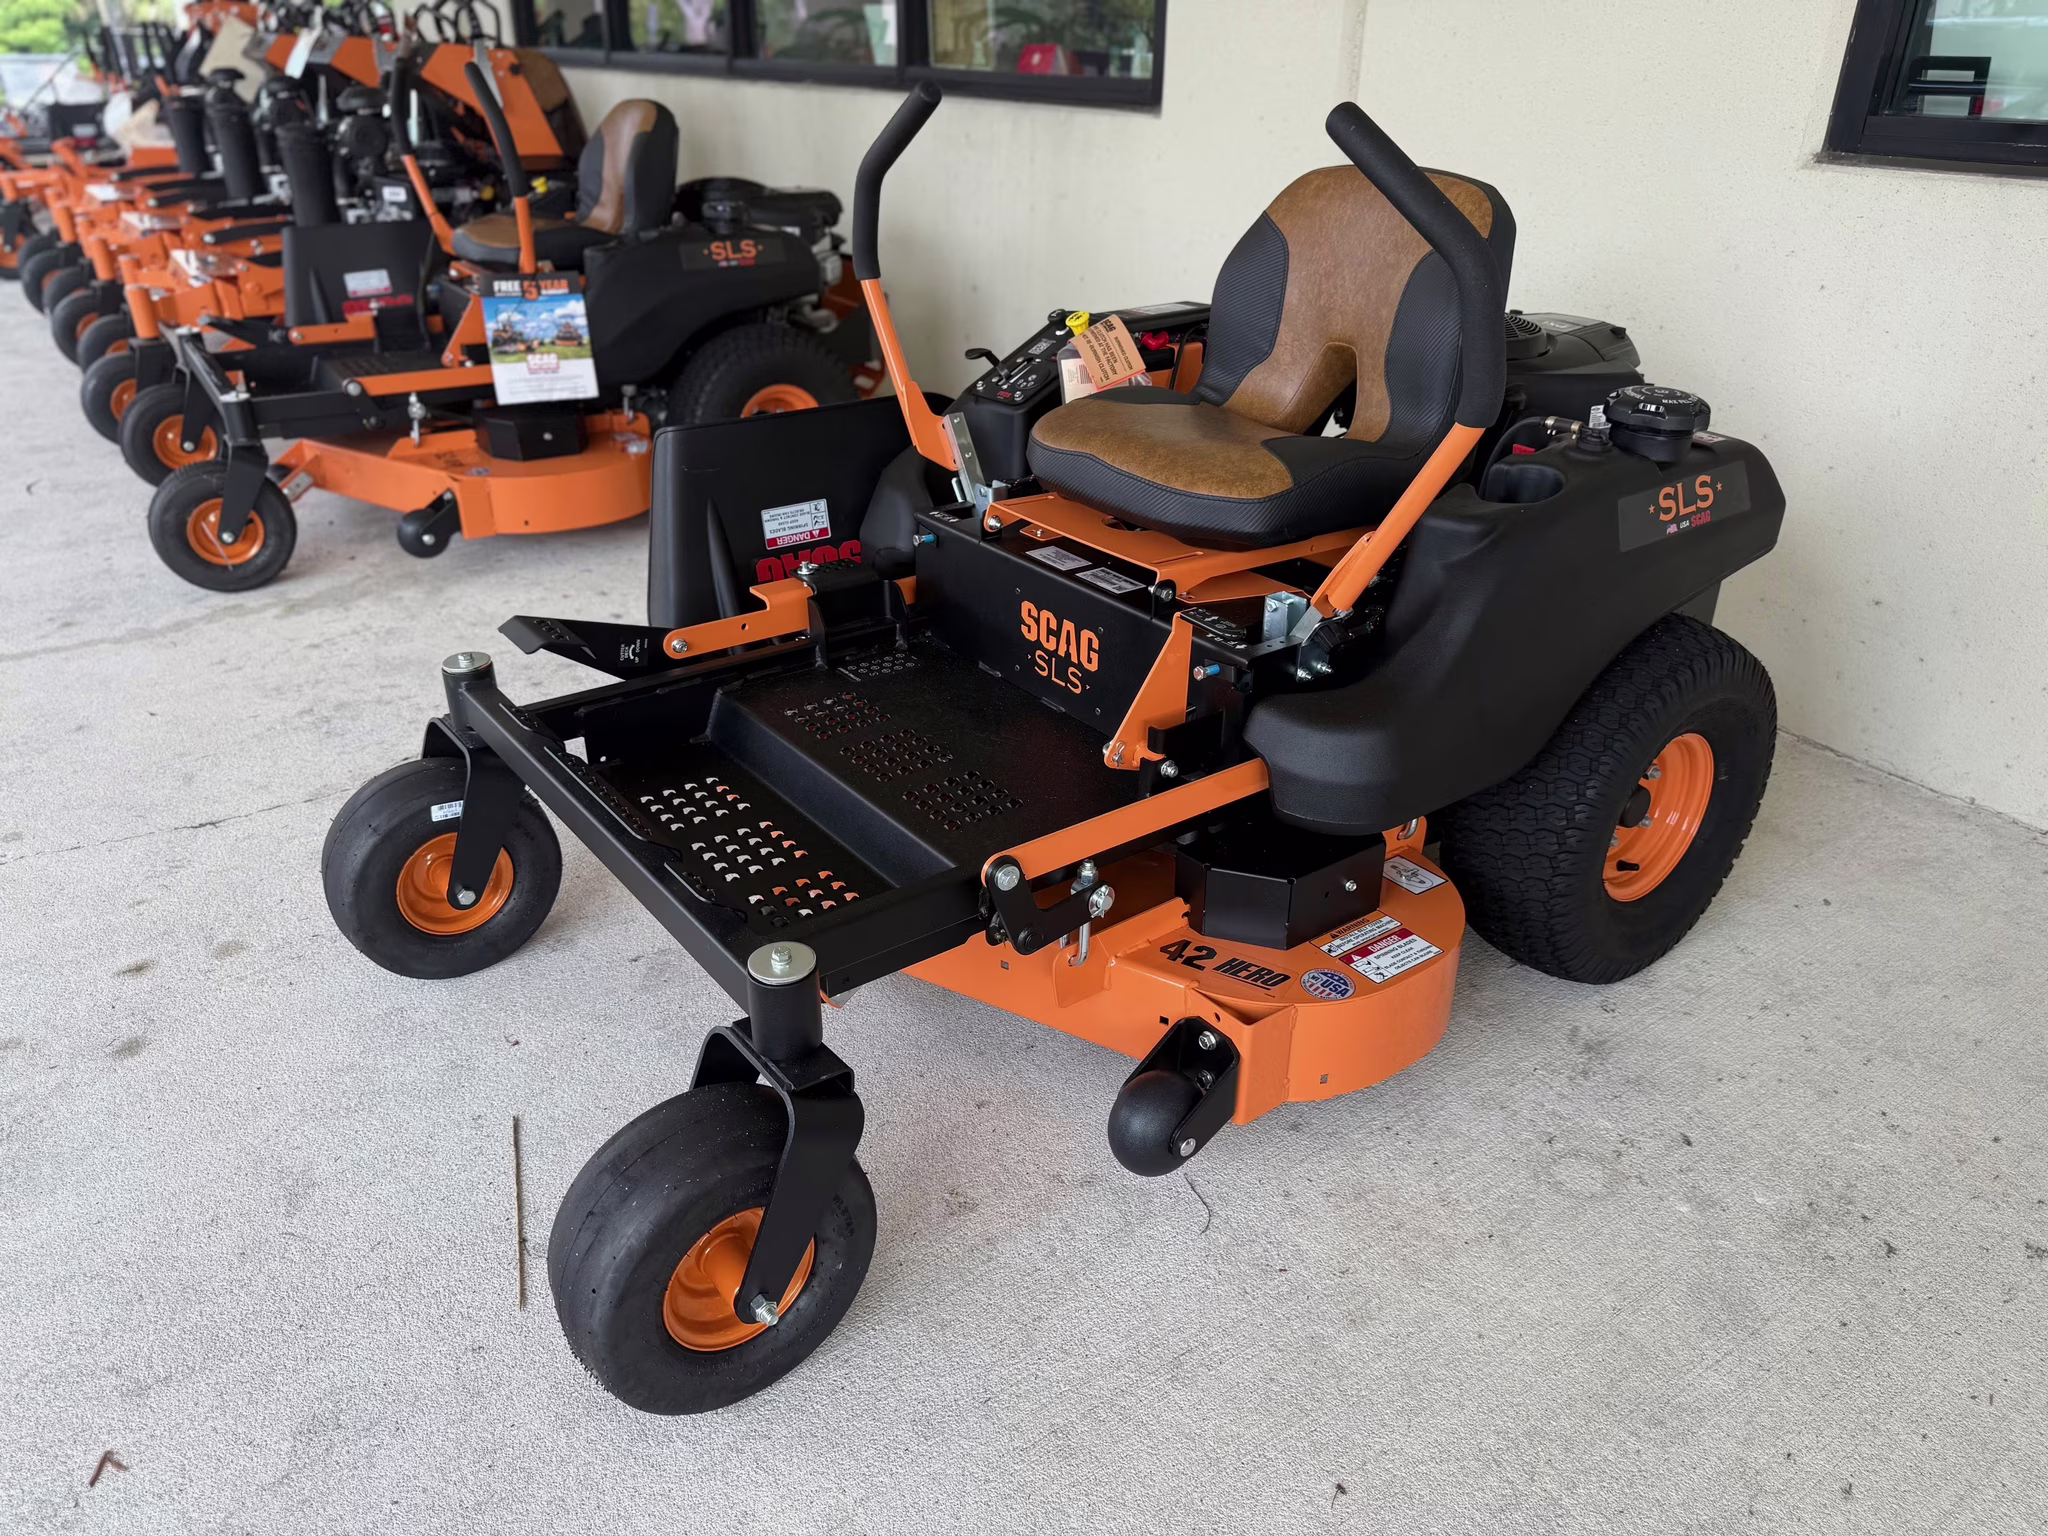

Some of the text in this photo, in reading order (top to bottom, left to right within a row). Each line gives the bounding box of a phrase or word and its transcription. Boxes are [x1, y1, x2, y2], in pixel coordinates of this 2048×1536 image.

[710, 239, 757, 260] SLS
[493, 280, 521, 292] FREE
[522, 281, 539, 301] 5
[540, 279, 570, 290] YEAR
[1098, 362, 1110, 380] CLUTCH
[1105, 355, 1118, 375] FACTORY
[1123, 355, 1133, 370] CLUTCH
[1658, 475, 1714, 522] SLS
[1679, 510, 1711, 529] USA SCAG
[776, 531, 811, 546] DANGER
[1020, 600, 1099, 672] SCAG
[1034, 650, 1082, 694] SLS
[1338, 918, 1370, 935] WARNING
[1367, 934, 1402, 952] DANGER
[1374, 938, 1417, 960] SPINNING BLADES
[1160, 939, 1218, 971] 42
[1212, 957, 1291, 988] HERO
[1320, 979, 1350, 998] USA
